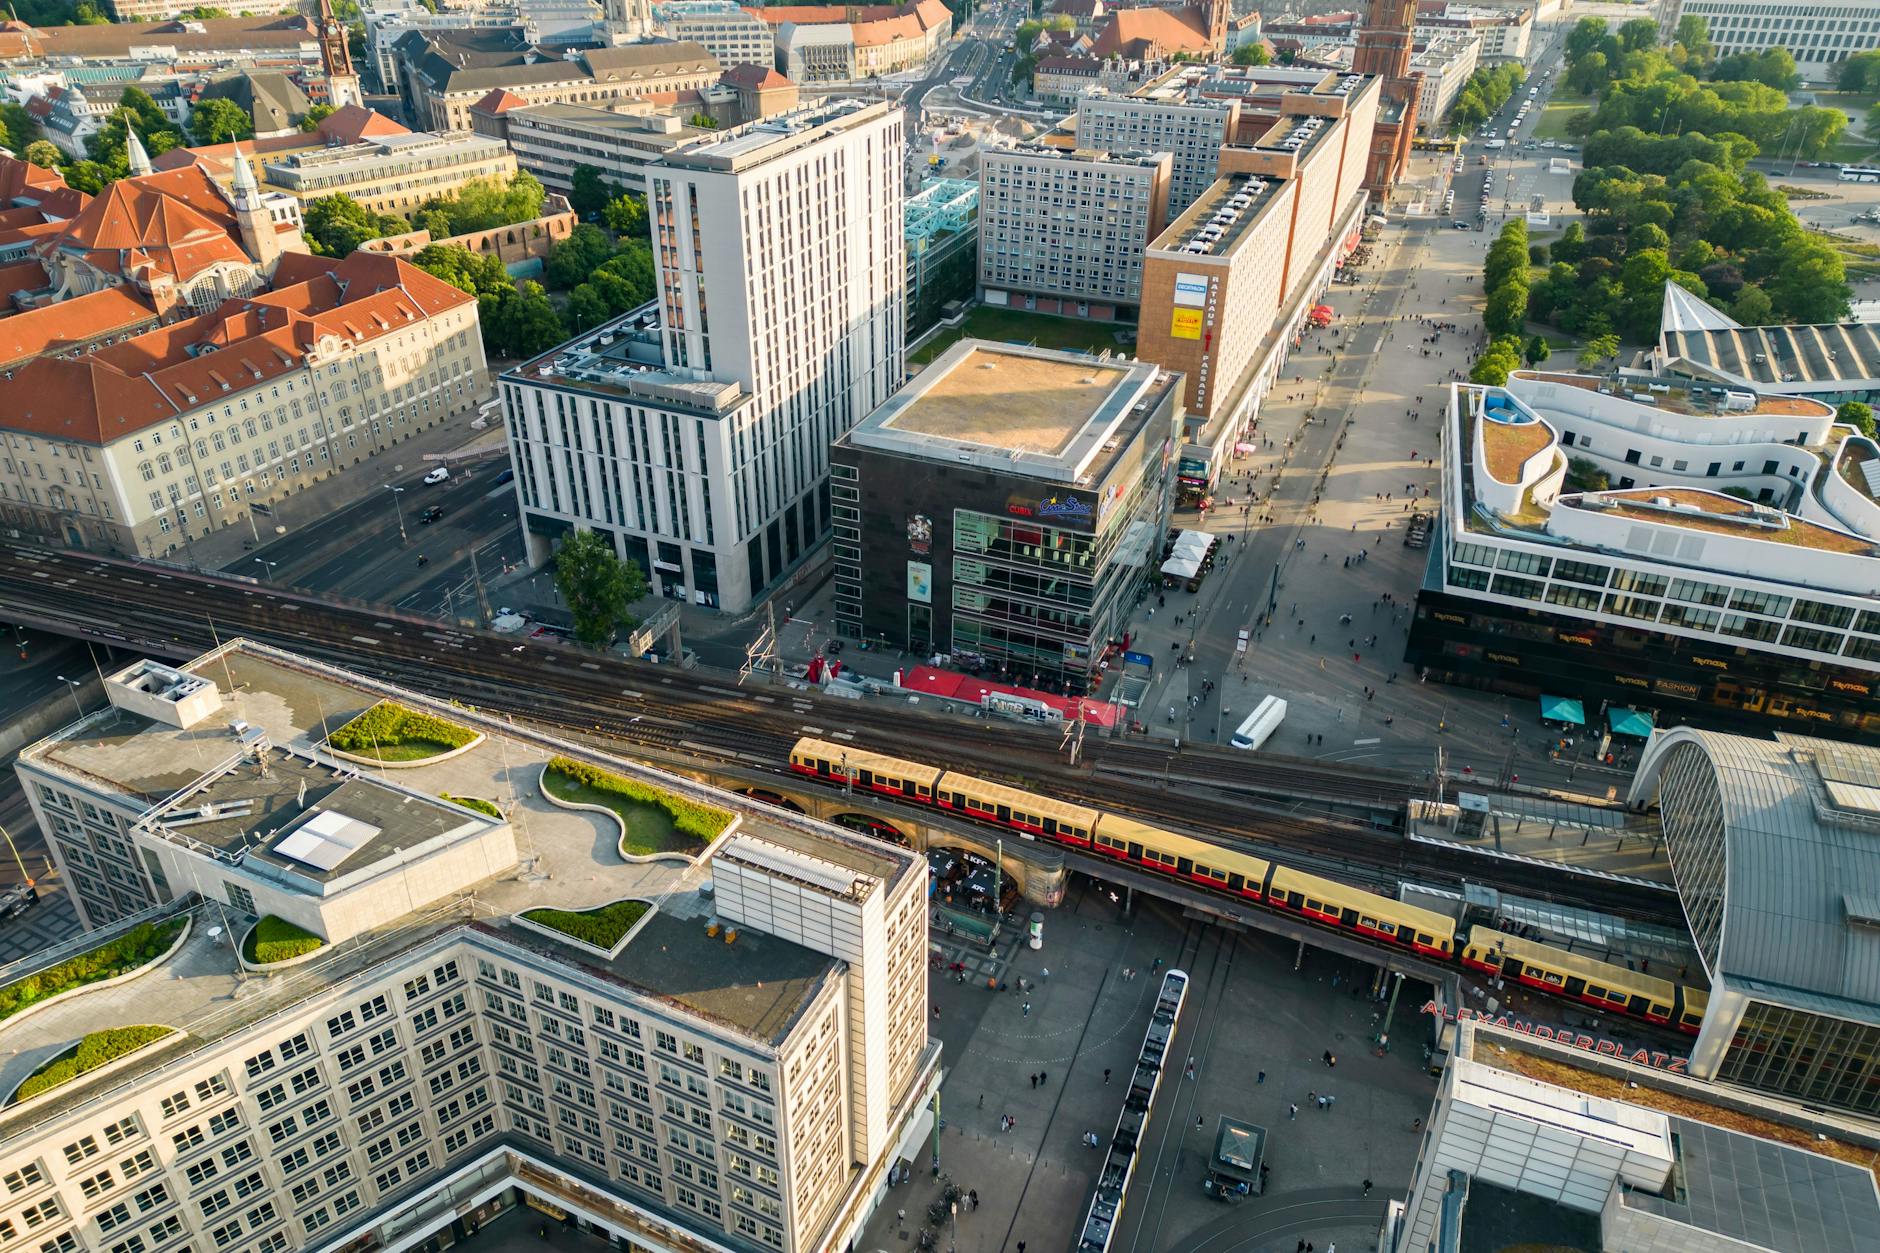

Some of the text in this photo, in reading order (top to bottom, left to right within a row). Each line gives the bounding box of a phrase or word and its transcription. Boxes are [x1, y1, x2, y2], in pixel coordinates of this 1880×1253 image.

[1207, 276, 1219, 327] RATHAUS
[1196, 355, 1209, 408] PASSAGEN
[1656, 680, 1697, 693] FASHION
[970, 856, 987, 865] KFC
[971, 884, 985, 892] KFC
[1420, 1000, 1690, 1073] ALEXANDERPLATZ
